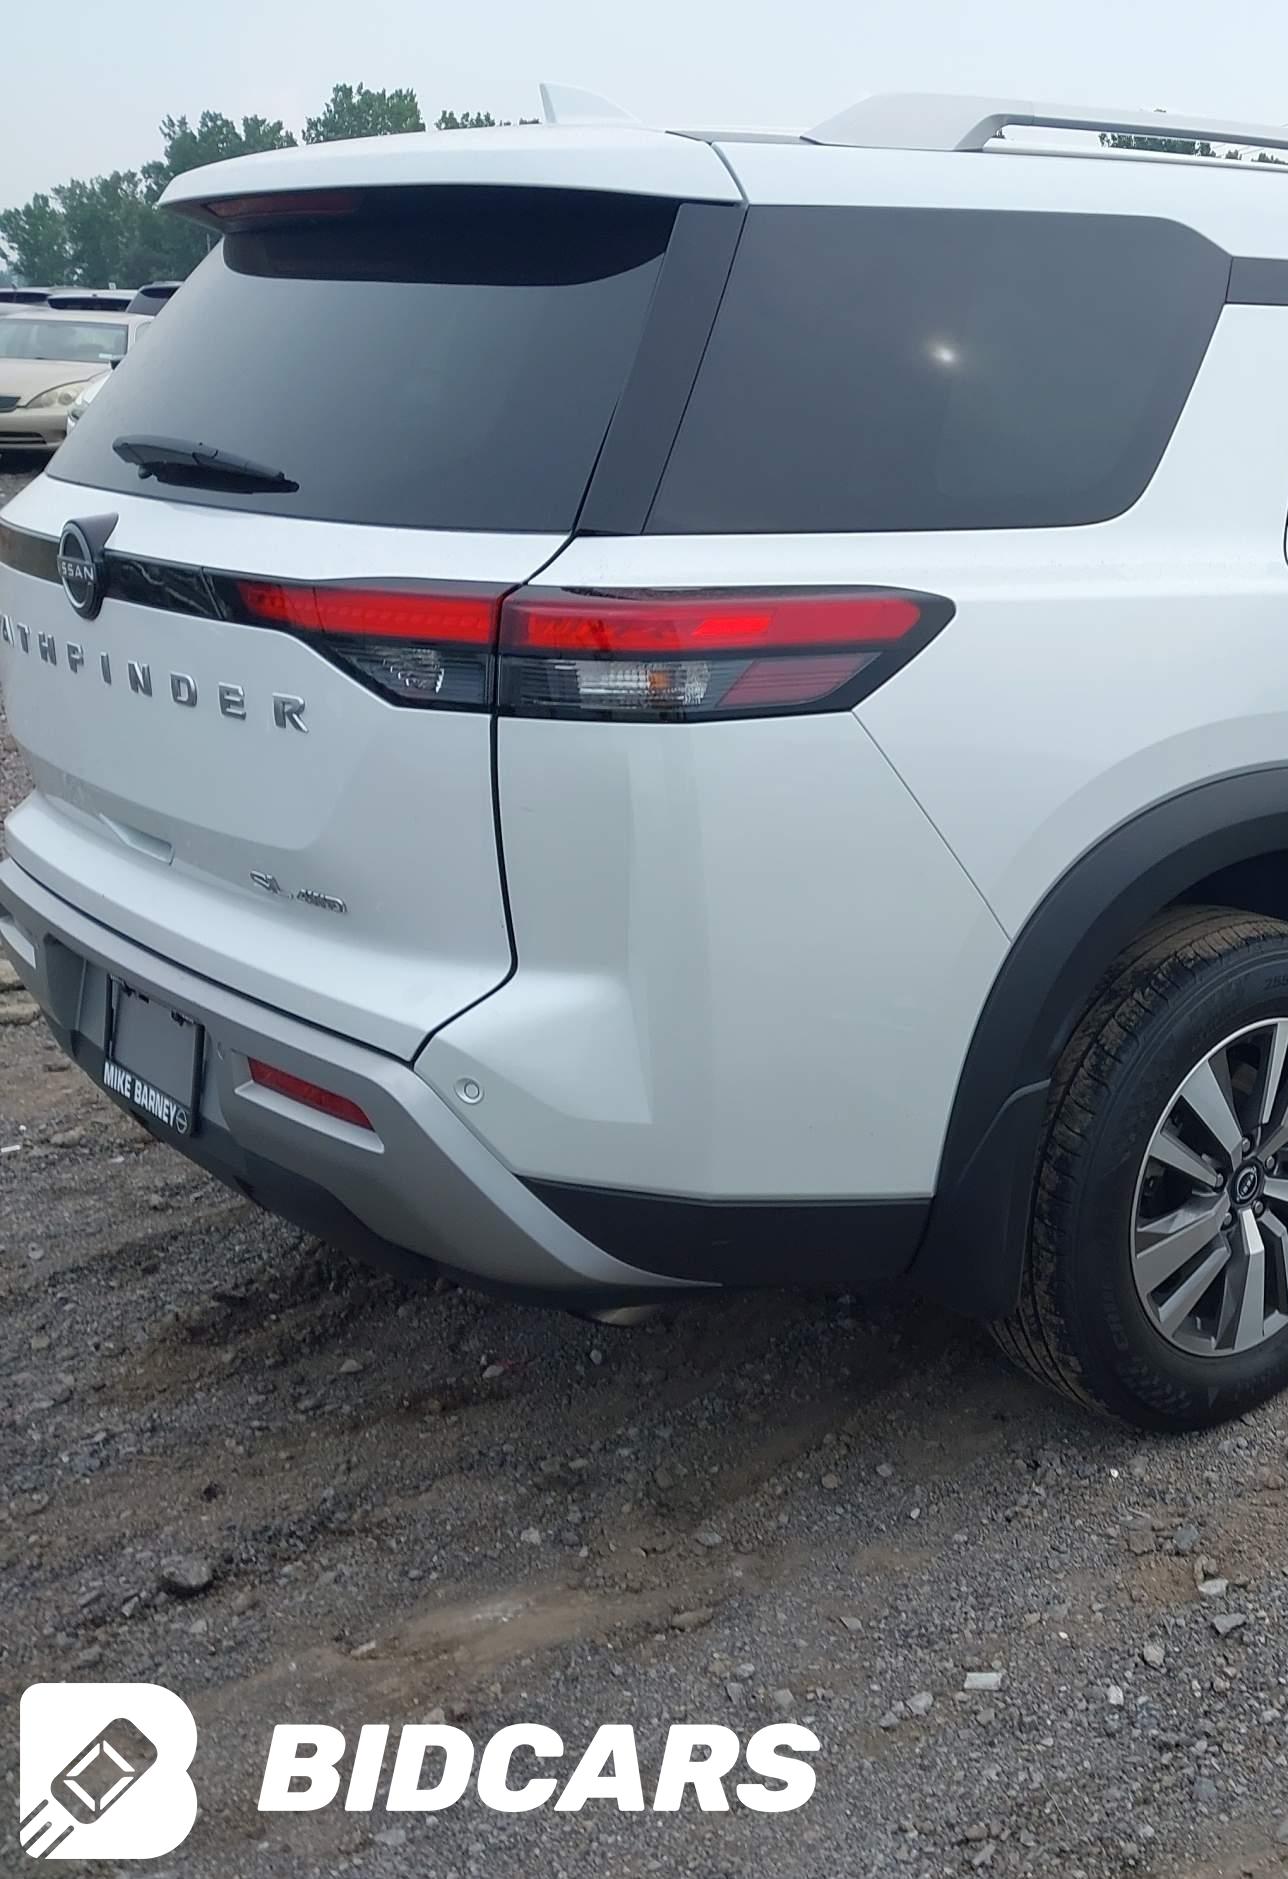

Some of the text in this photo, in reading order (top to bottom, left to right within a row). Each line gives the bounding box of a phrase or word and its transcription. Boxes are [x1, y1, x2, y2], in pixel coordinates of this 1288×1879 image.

[60, 560, 94, 581] SSAN
[0, 613, 310, 733] ATHFINDER
[103, 1061, 177, 1128] MIKE BARNEY
